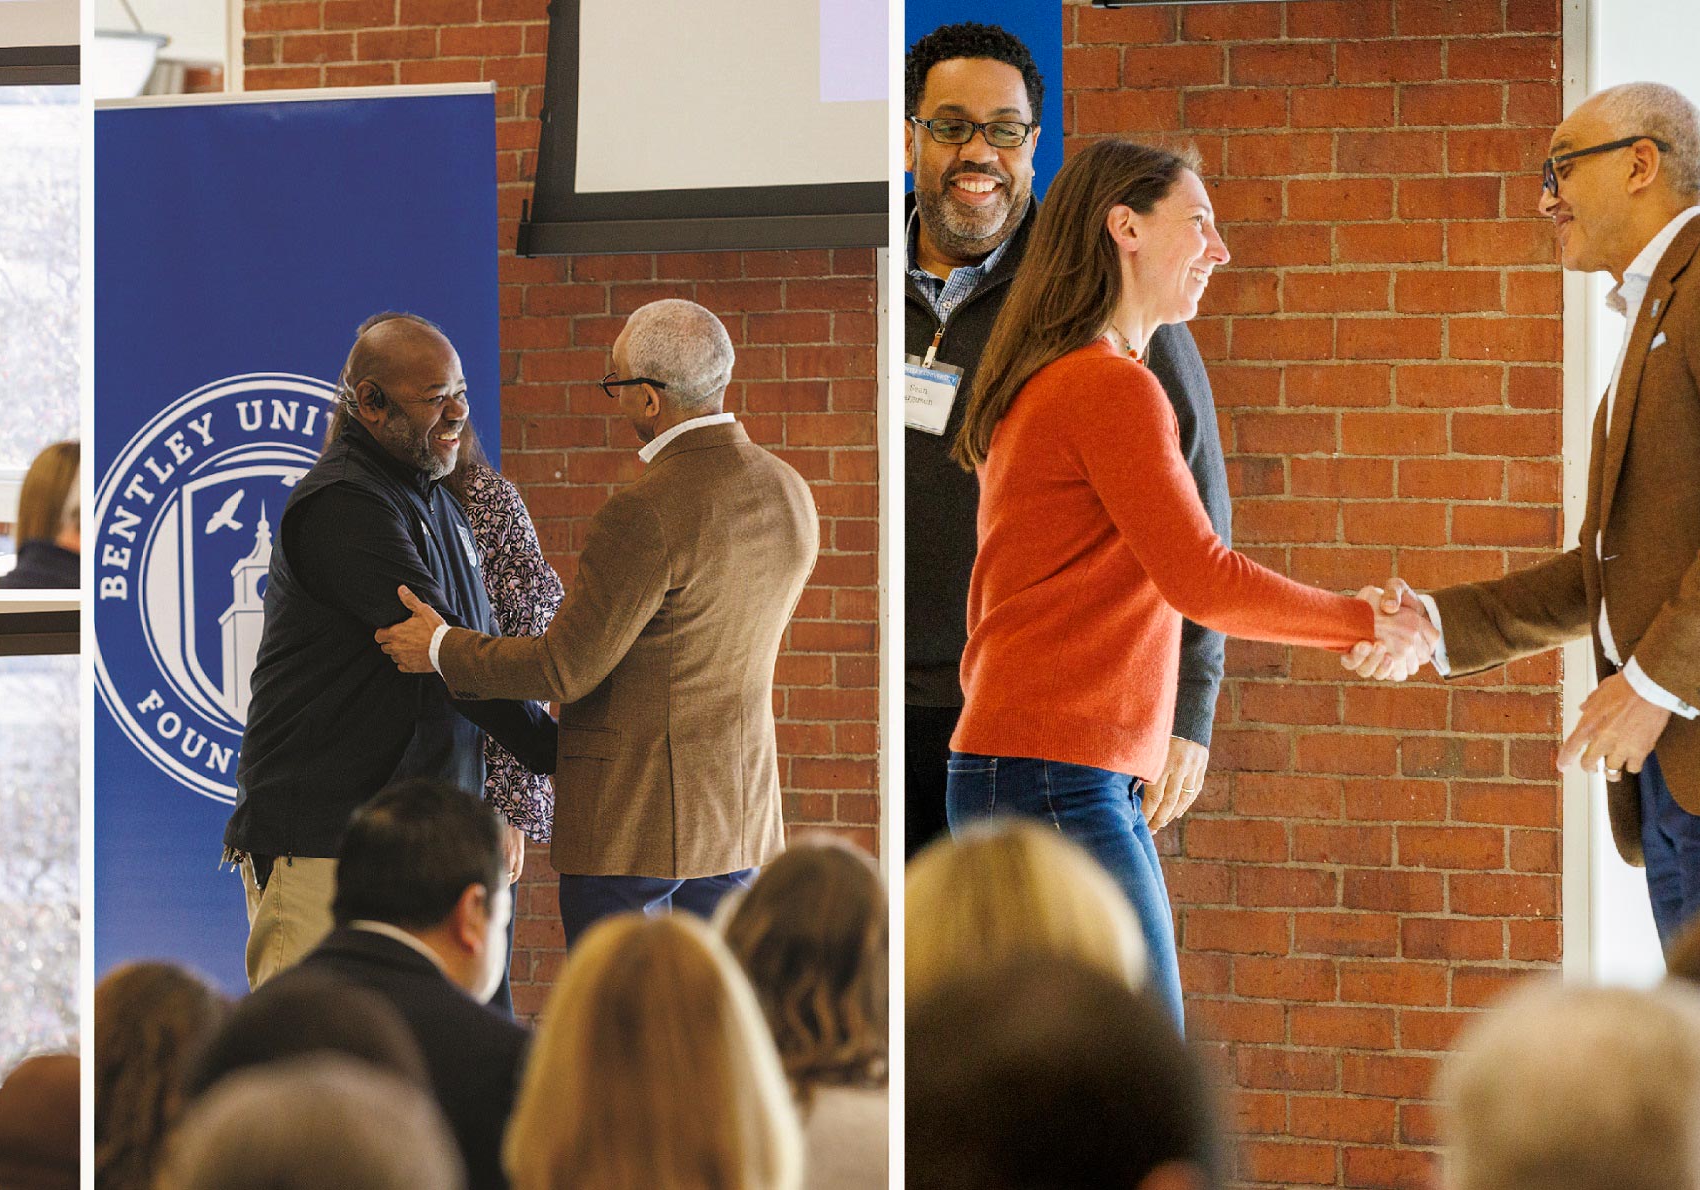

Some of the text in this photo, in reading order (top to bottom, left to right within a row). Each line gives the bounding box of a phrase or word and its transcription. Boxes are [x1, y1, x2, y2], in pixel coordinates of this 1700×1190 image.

[100, 399, 334, 600] BENTLEY UNI
[136, 689, 241, 774] FOUN
